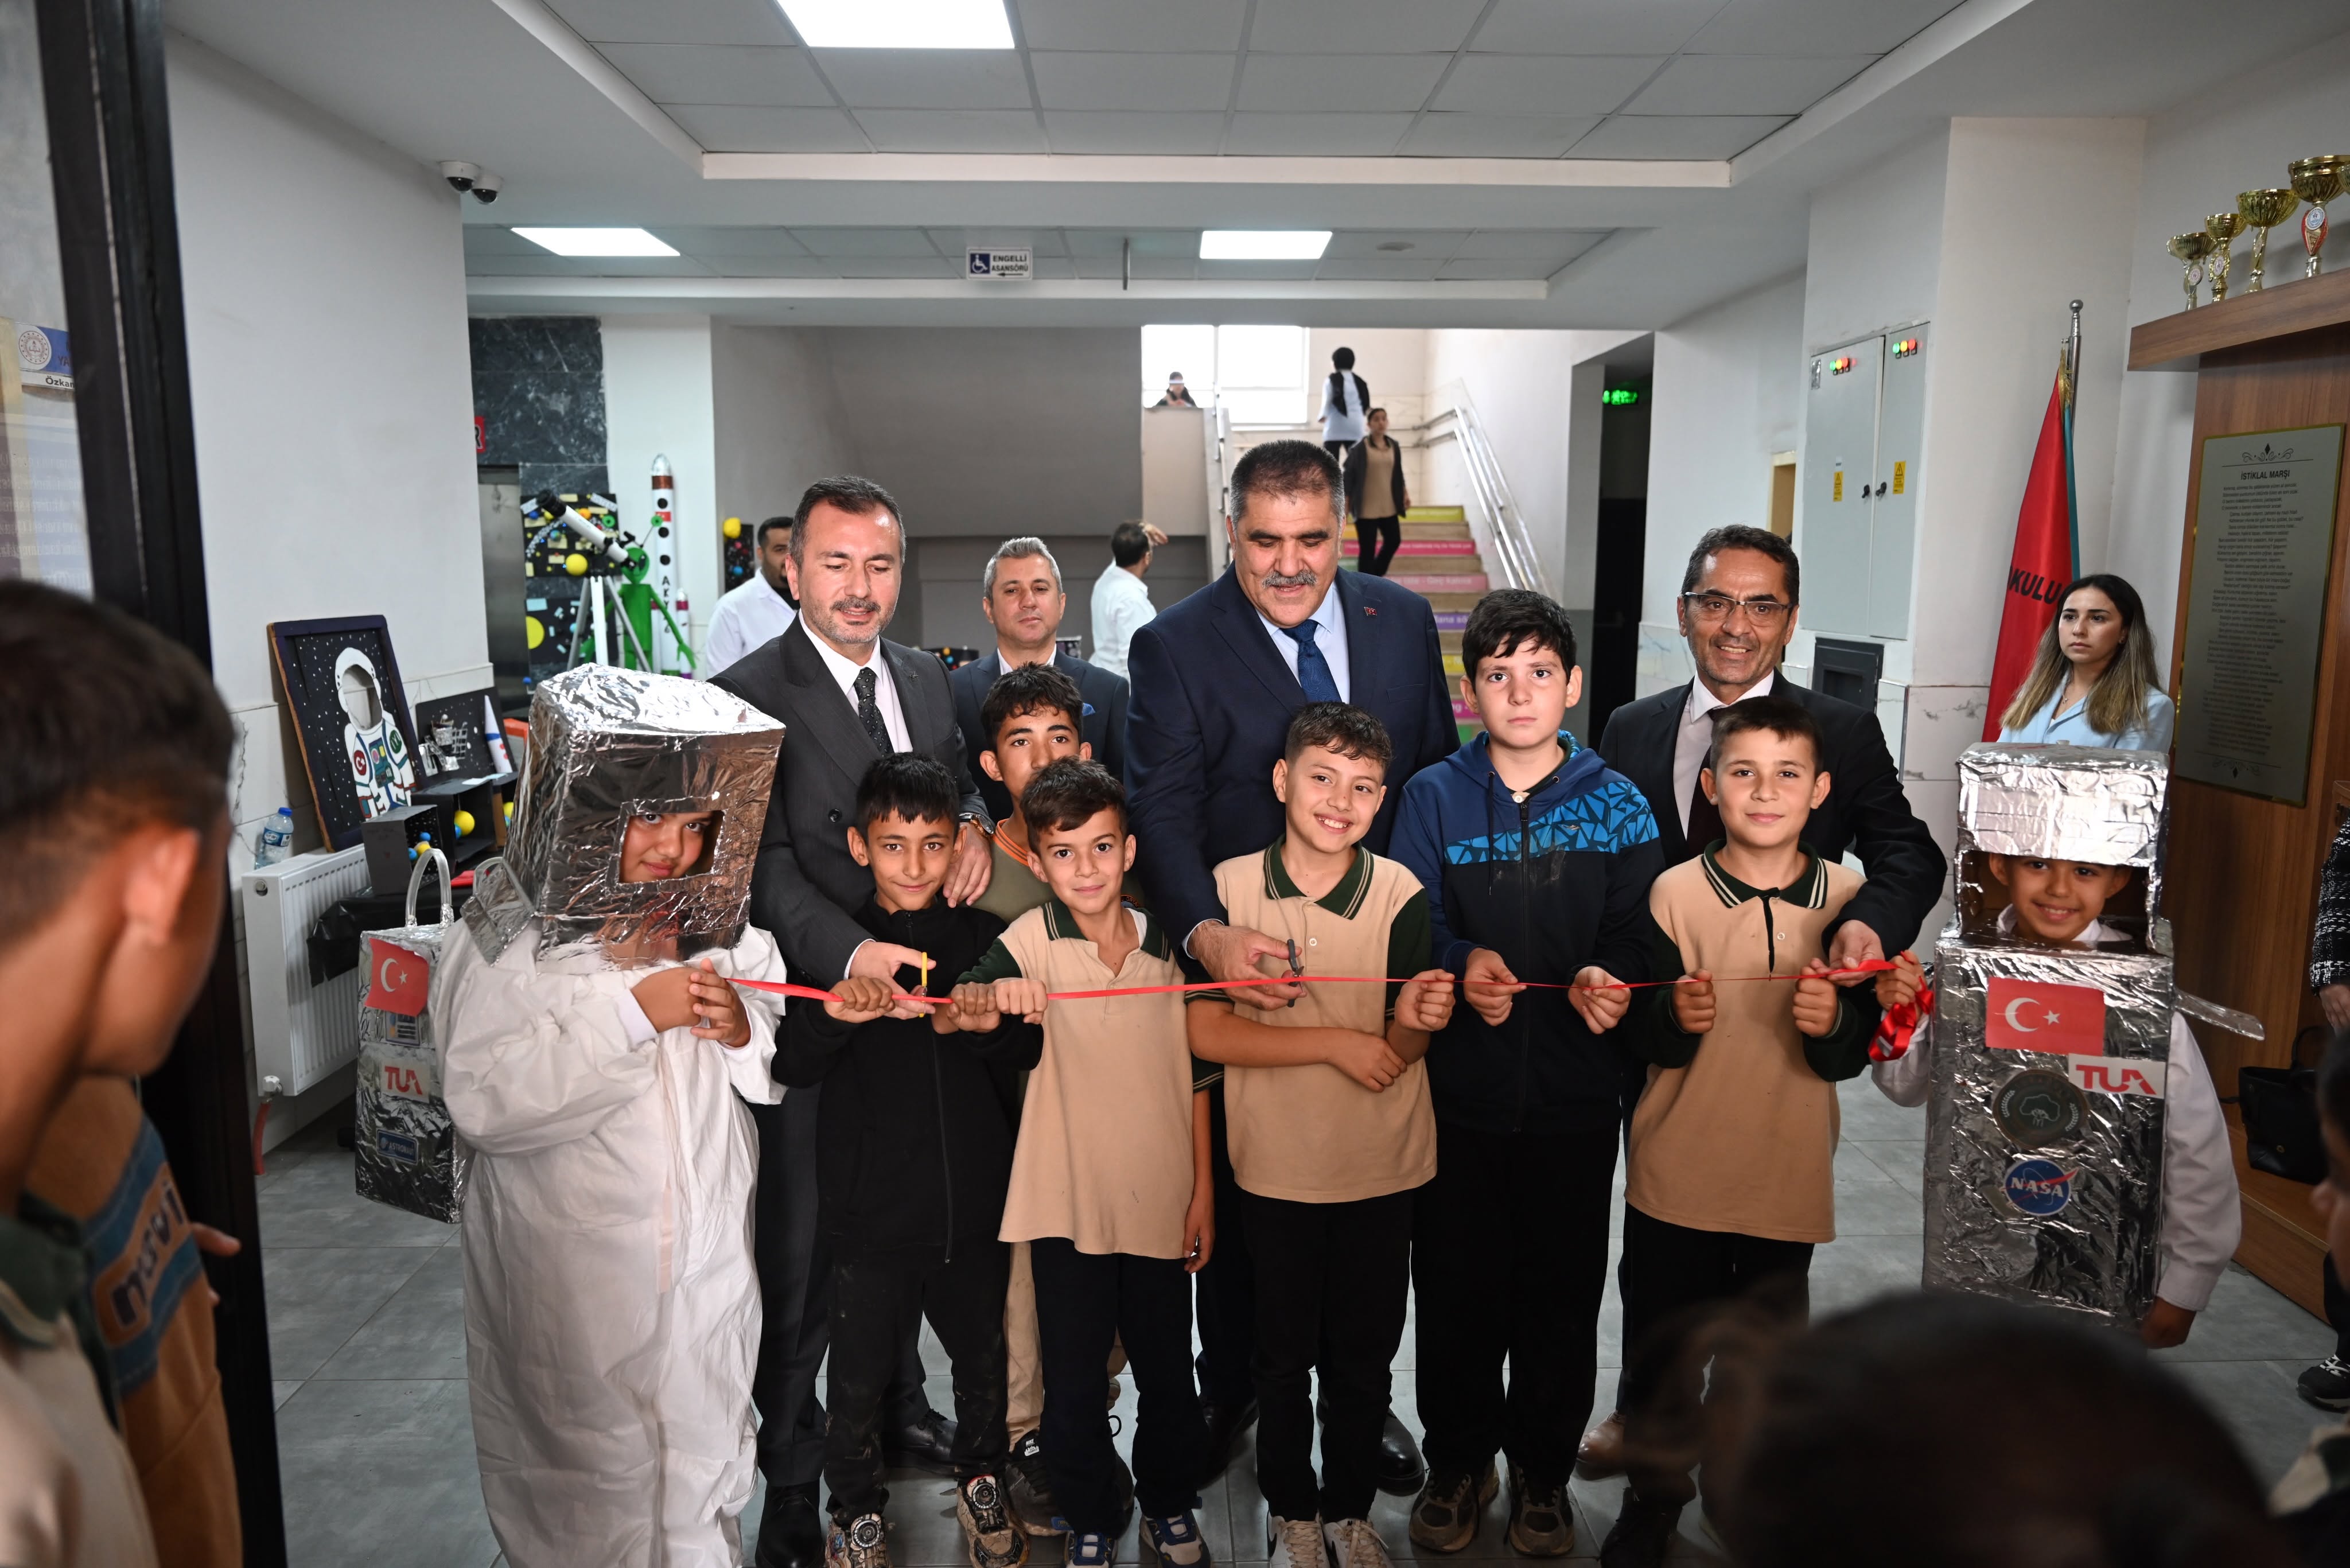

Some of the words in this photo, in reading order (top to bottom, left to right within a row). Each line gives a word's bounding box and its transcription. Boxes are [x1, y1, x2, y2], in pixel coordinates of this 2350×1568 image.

[993, 254, 1027, 262] ENGELLİ
[991, 263, 1028, 271] ASANSÖRÜ
[58, 356, 72, 367] YA
[2240, 470, 2267, 480] İSTİKLAL
[2269, 469, 2290, 480] MARŞI
[384, 1065, 423, 1095] TUA
[2076, 1064, 2156, 1095] TUA
[2011, 1177, 2064, 1198] NASA
